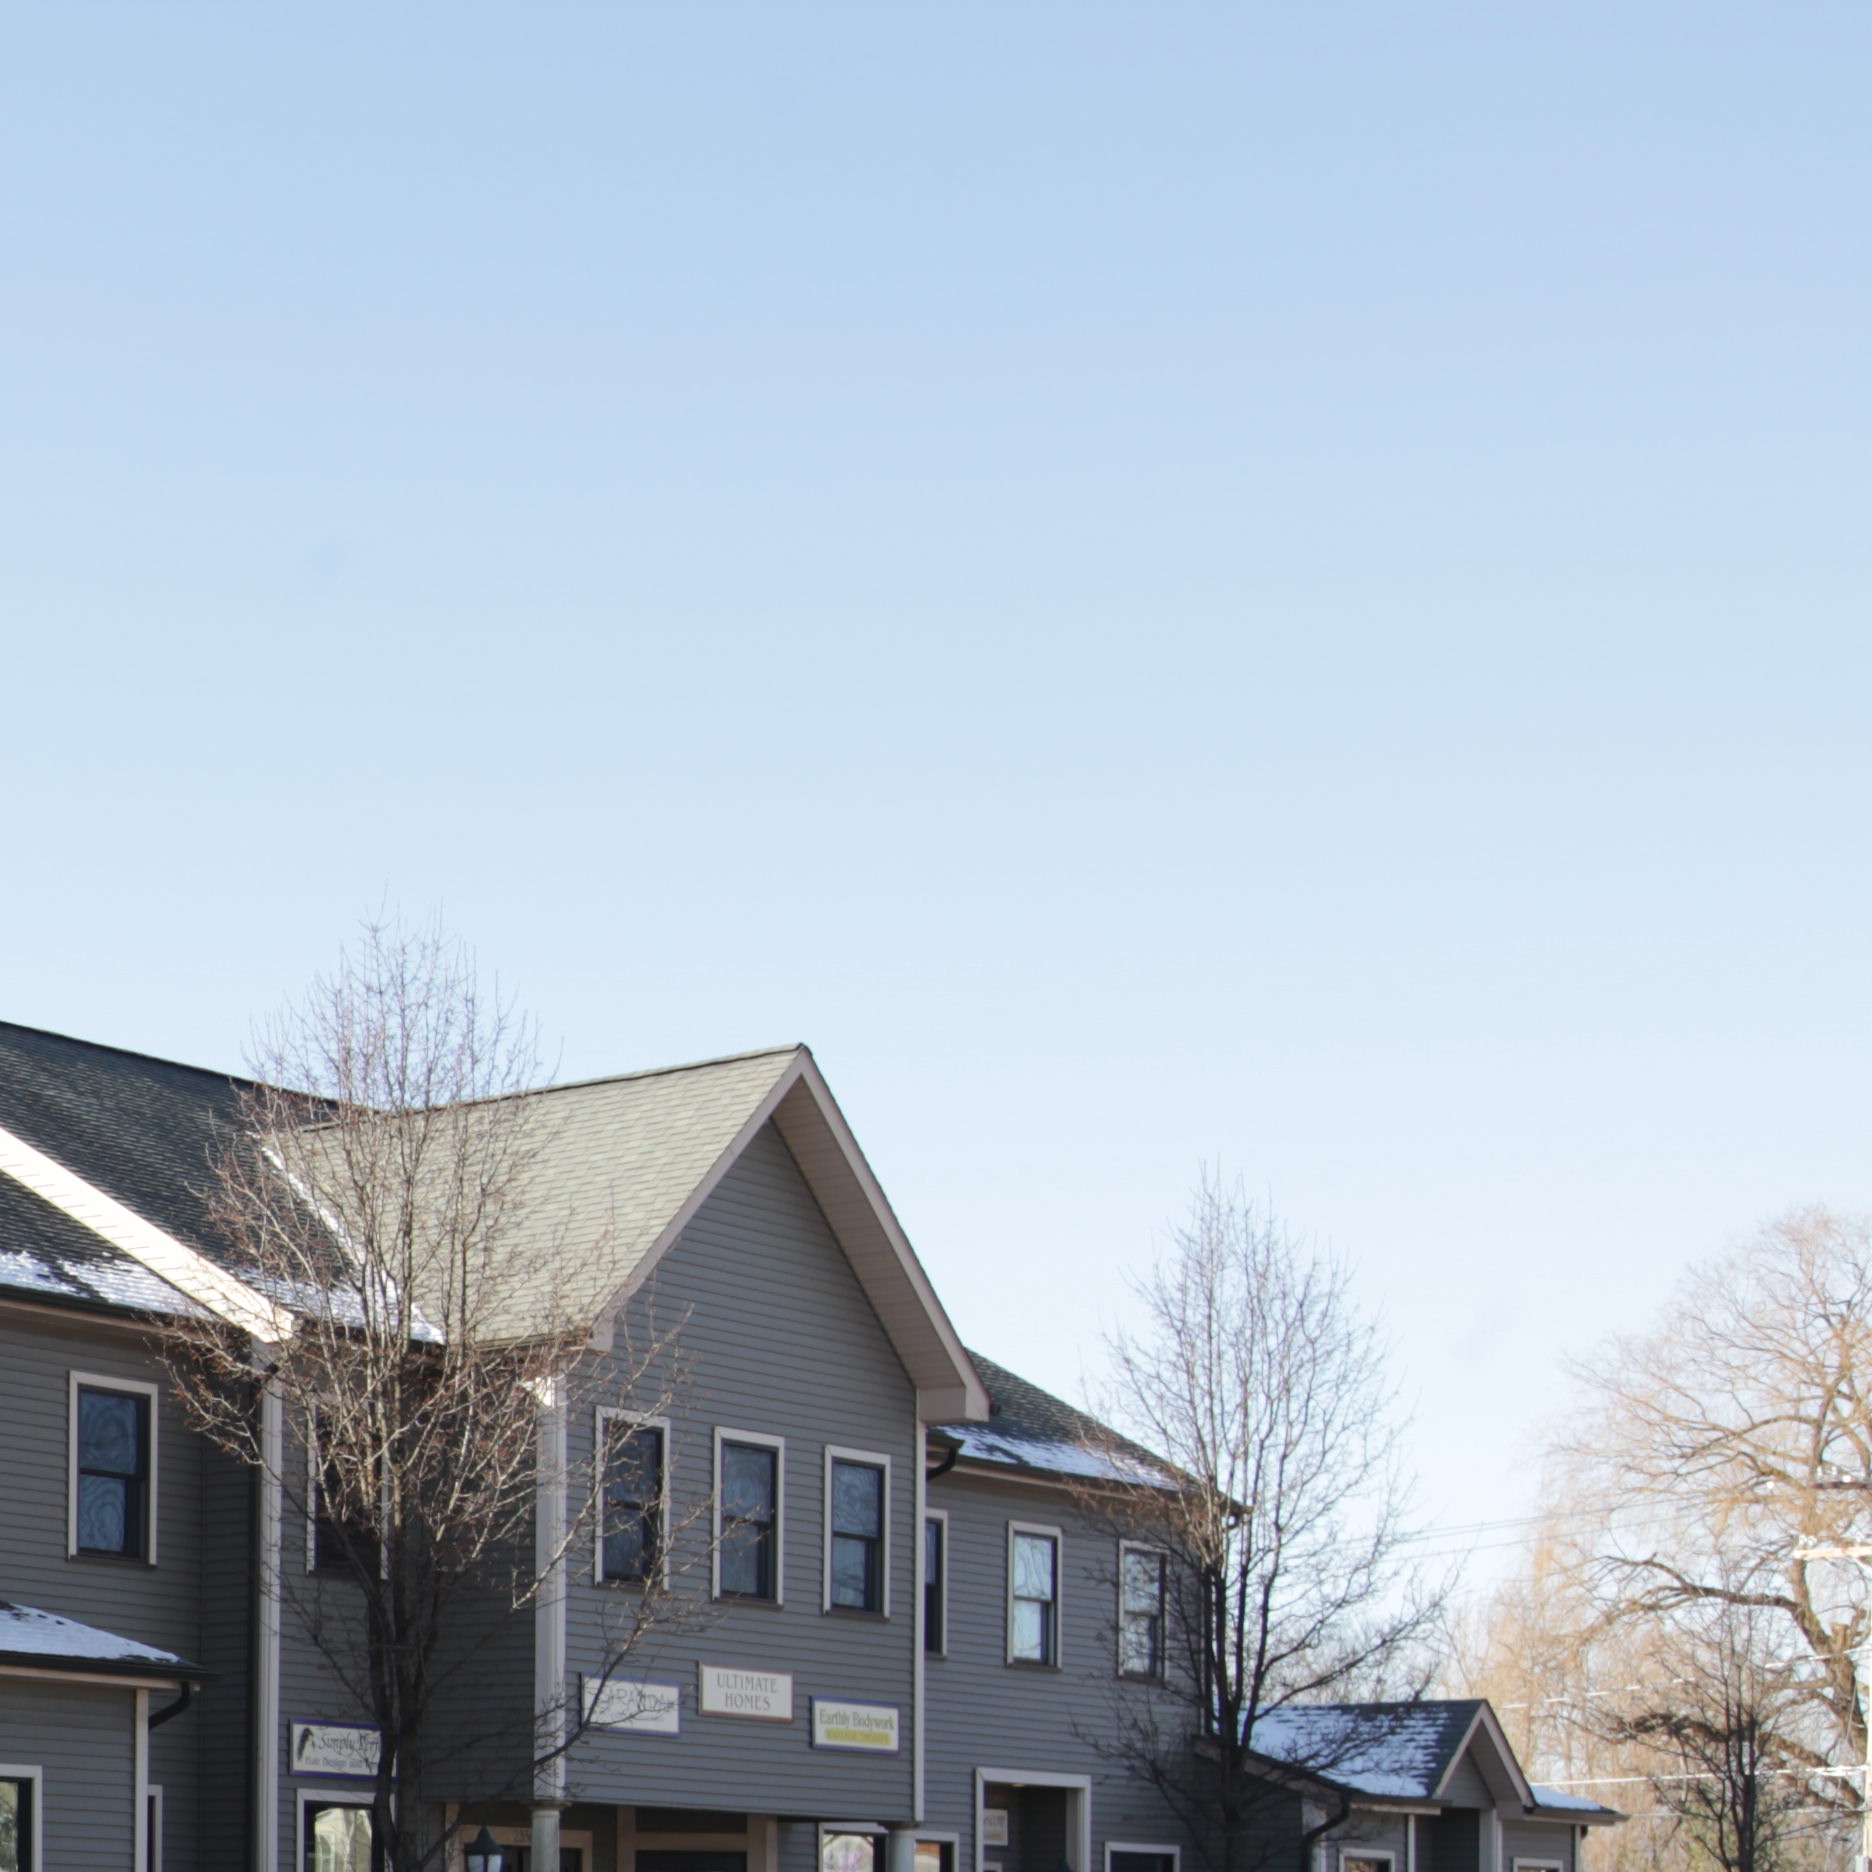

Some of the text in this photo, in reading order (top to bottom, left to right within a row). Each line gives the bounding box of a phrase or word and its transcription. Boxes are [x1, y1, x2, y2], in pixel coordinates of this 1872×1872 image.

[717, 1672, 779, 1693] ULTIMATE
[724, 1692, 771, 1711] HOMES
[819, 1709, 895, 1732] Earthly Bodywork
